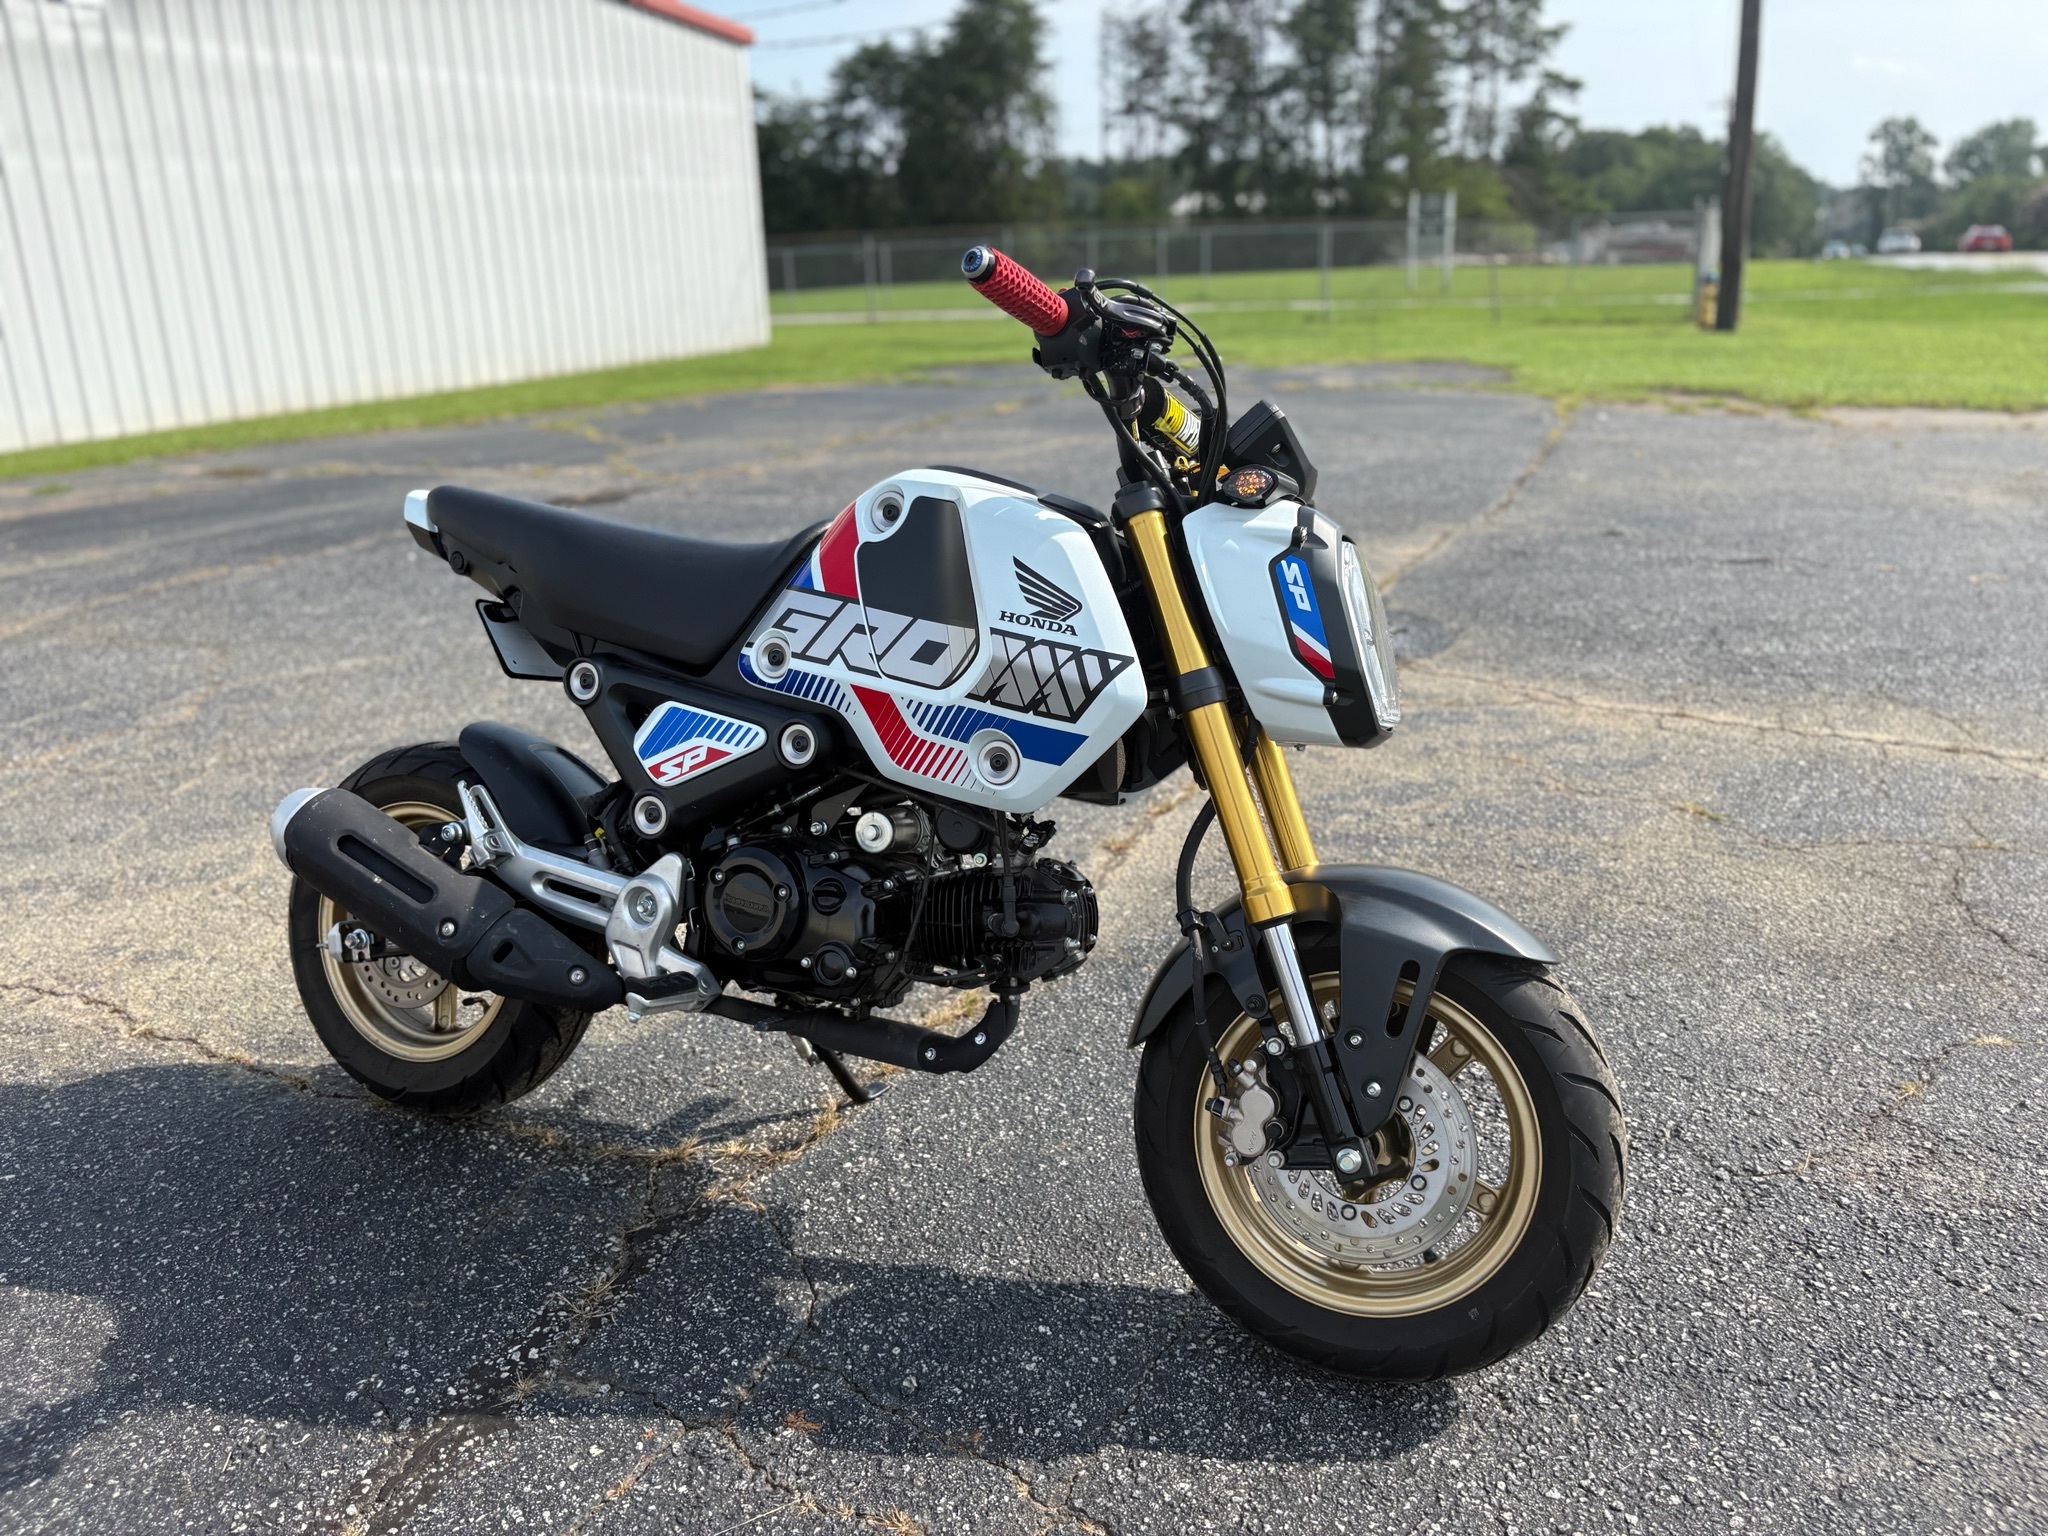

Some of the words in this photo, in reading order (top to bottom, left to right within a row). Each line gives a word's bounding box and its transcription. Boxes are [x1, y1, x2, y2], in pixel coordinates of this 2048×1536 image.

[1281, 559, 1312, 612] SP
[998, 610, 1079, 637] HONDA
[657, 745, 707, 784] SP
